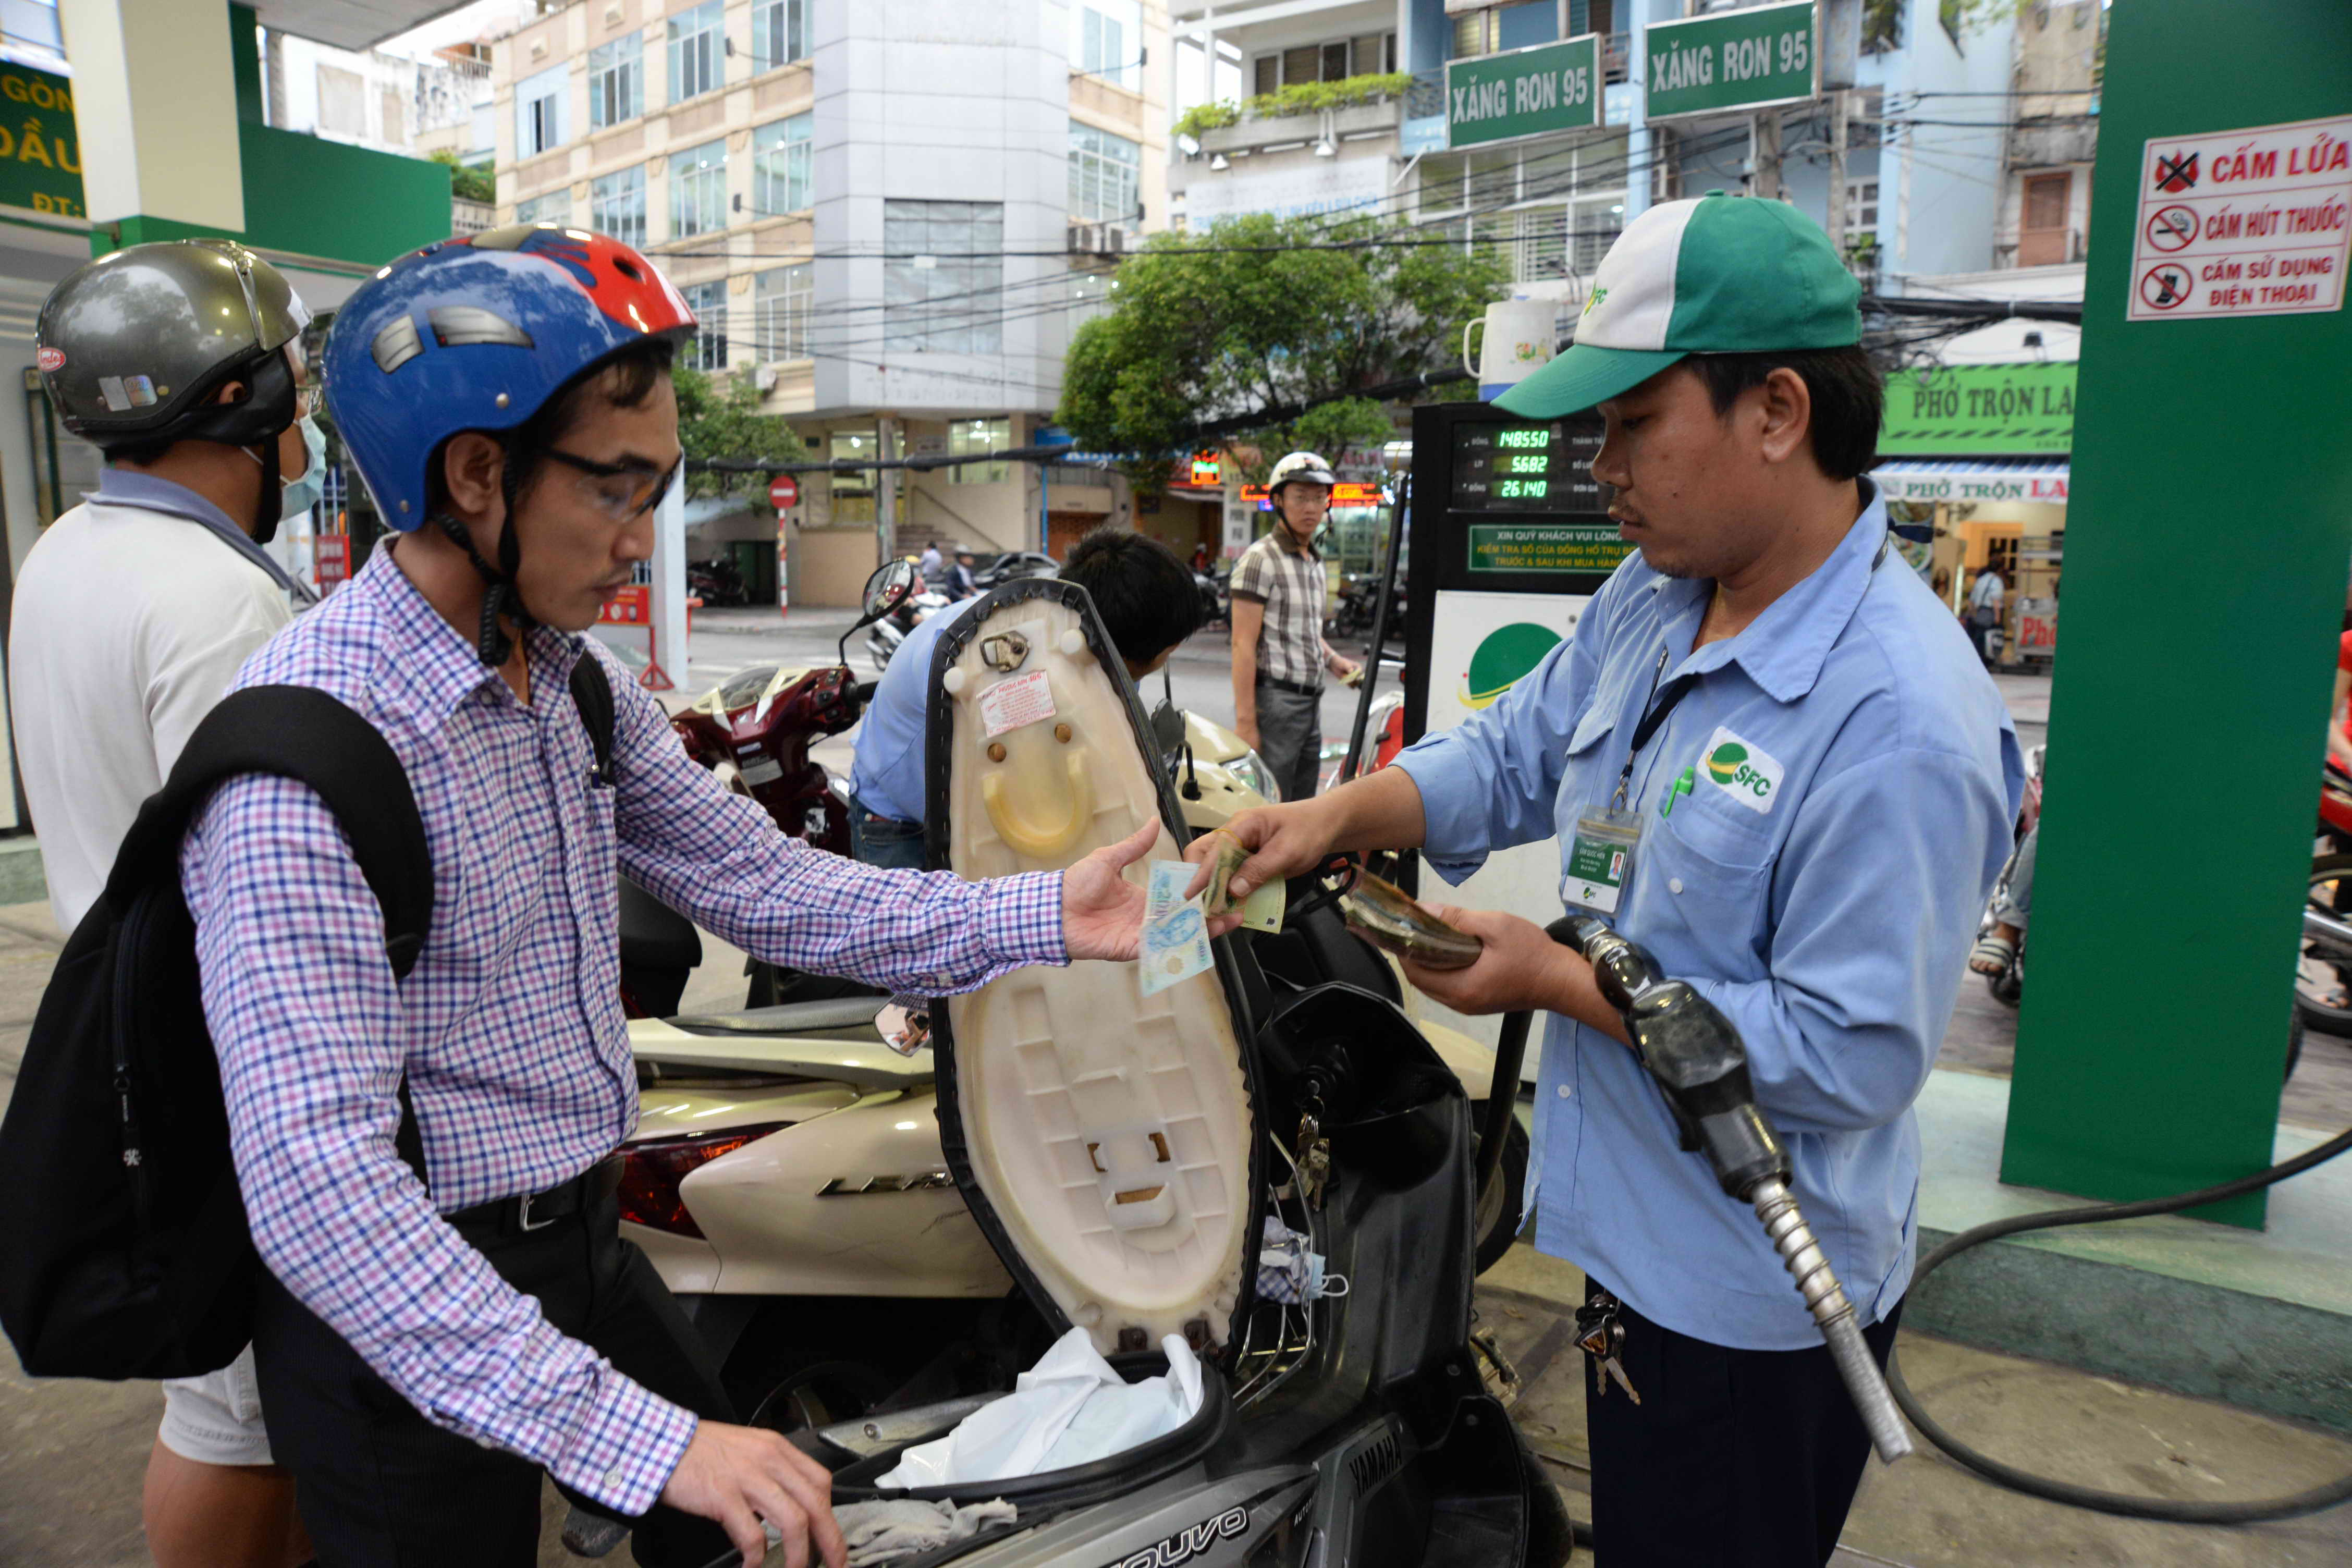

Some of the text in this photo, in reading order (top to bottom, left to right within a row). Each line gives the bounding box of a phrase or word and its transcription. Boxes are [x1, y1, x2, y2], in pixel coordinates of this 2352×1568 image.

[1652, 30, 1808, 93] XĂNG RON 95
[1453, 75, 1508, 125] XĂNG
[1515, 71, 1557, 114] RON
[1563, 67, 1588, 107] 95
[2212, 132, 2350, 183] CẤM LỬA
[2205, 193, 2346, 240] CẤM HÚT THUỐC
[2201, 254, 2334, 282] CẤM SỬ DỤNG
[2209, 283, 2318, 310] ĐIỆN THOẠI
[1913, 374, 1962, 419] PHỞ
[1967, 377, 2035, 424] TRỘN
[1499, 430, 1549, 448] 148550
[1905, 478, 1952, 498] PHỞ
[1959, 481, 2025, 500] TRỘN
[1497, 531, 1512, 540] XIN
[1539, 530, 1574, 541] KHÁCH
[1576, 532, 1592, 541] VUI
[1502, 545, 1520, 554] TRA
[1536, 558, 1554, 567] SAU
[1557, 559, 1572, 567] KHI
[1574, 559, 1594, 567] MUA
[1734, 764, 1771, 797] SFC
[1349, 1431, 1403, 1498] YAMAHA
[1109, 1506, 1248, 1568] OUVO
